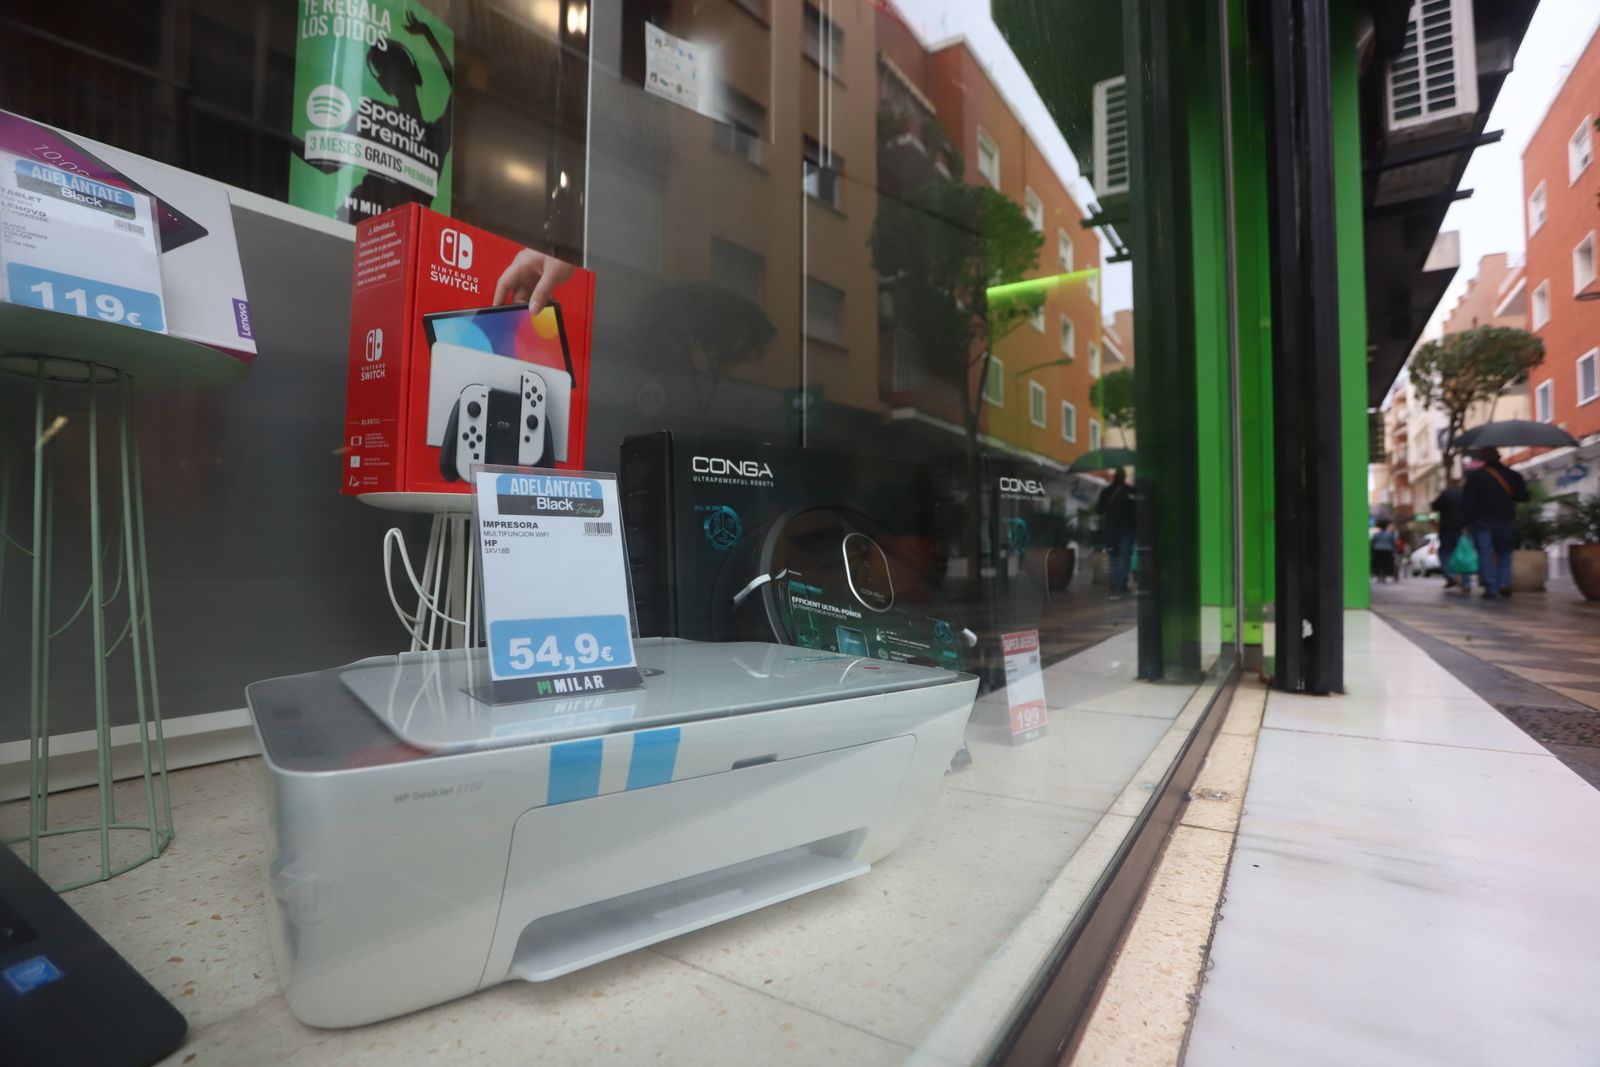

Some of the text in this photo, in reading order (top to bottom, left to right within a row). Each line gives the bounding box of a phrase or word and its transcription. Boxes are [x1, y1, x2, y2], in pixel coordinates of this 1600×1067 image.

[323, 0, 391, 32] REGALA
[302, 15, 328, 39] LOS
[359, 96, 425, 141] Spotify
[357, 115, 439, 167] Premium
[310, 136, 317, 150] 3
[320, 136, 362, 159] MESES
[365, 146, 402, 173] GRATIS
[61, 187, 103, 208] Black
[430, 271, 479, 294] SWITCH
[431, 263, 479, 283] NINTENDO
[241, 302, 251, 336] Lenovo
[361, 363, 385, 371] NINTENDO
[361, 369, 385, 382] SWITCH
[692, 456, 773, 478] CONGA
[510, 476, 592, 499] ADELÁNTATE
[693, 475, 748, 486] ULTRAPOWERFUL
[1000, 476, 1046, 495] CONGA
[536, 496, 574, 511] Black
[483, 520, 539, 529] IMPRESORA
[792, 596, 862, 619] EFFICIENT ULTRA-POWER
[553, 674, 605, 694] MILAR
[395, 793, 410, 803] HP
